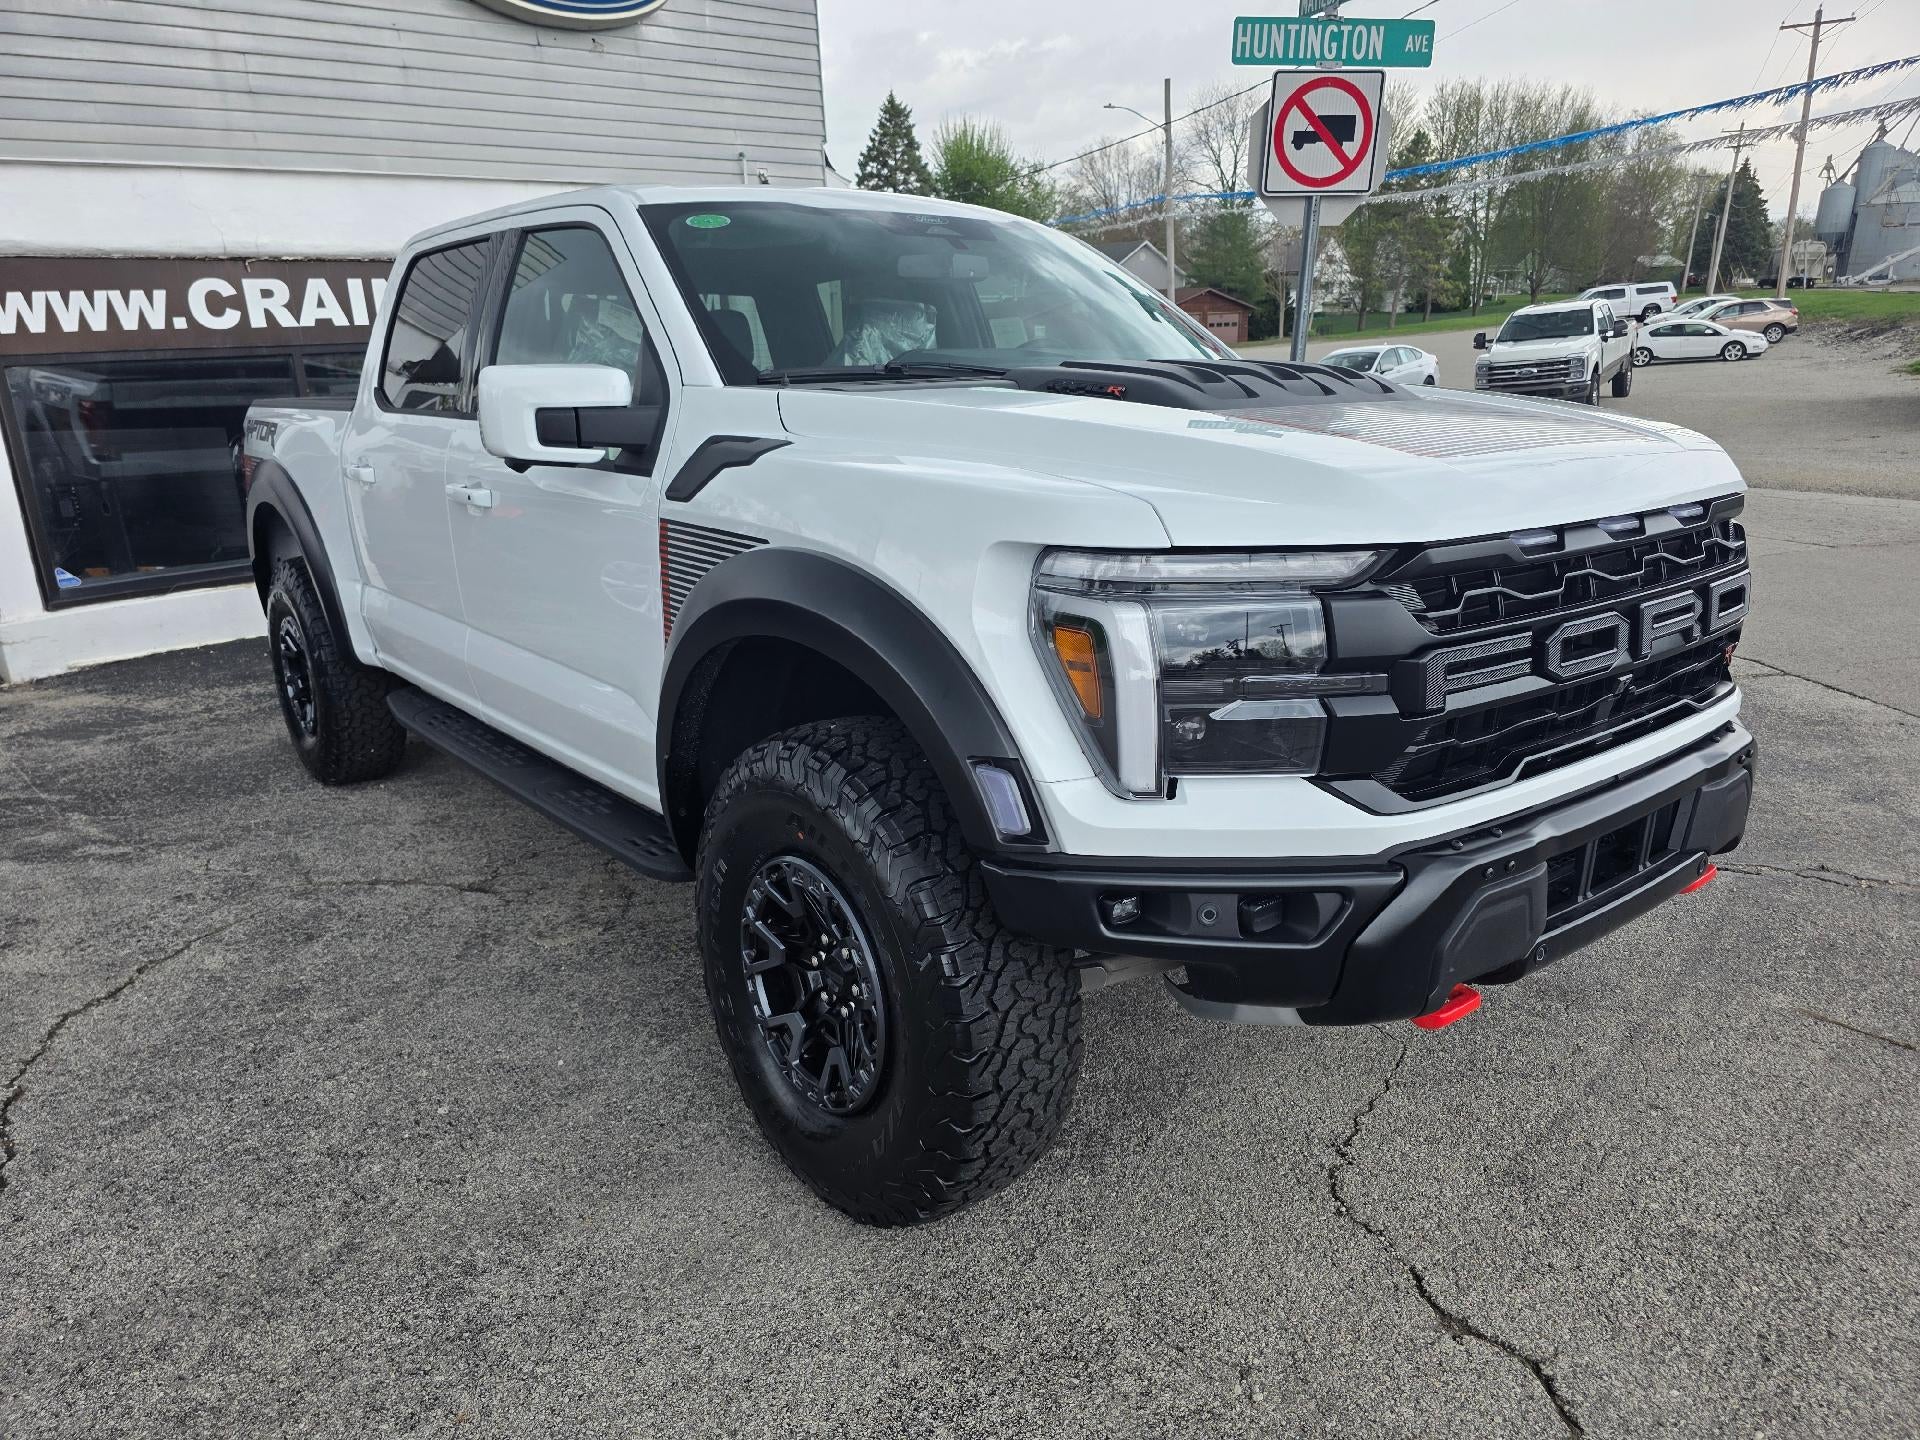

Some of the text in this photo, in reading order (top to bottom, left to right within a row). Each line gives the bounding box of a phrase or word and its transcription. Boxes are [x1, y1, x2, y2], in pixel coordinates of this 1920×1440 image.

[1236, 23, 1430, 60] HUNTINGTON AVE
[1424, 568, 1752, 712] FORD
